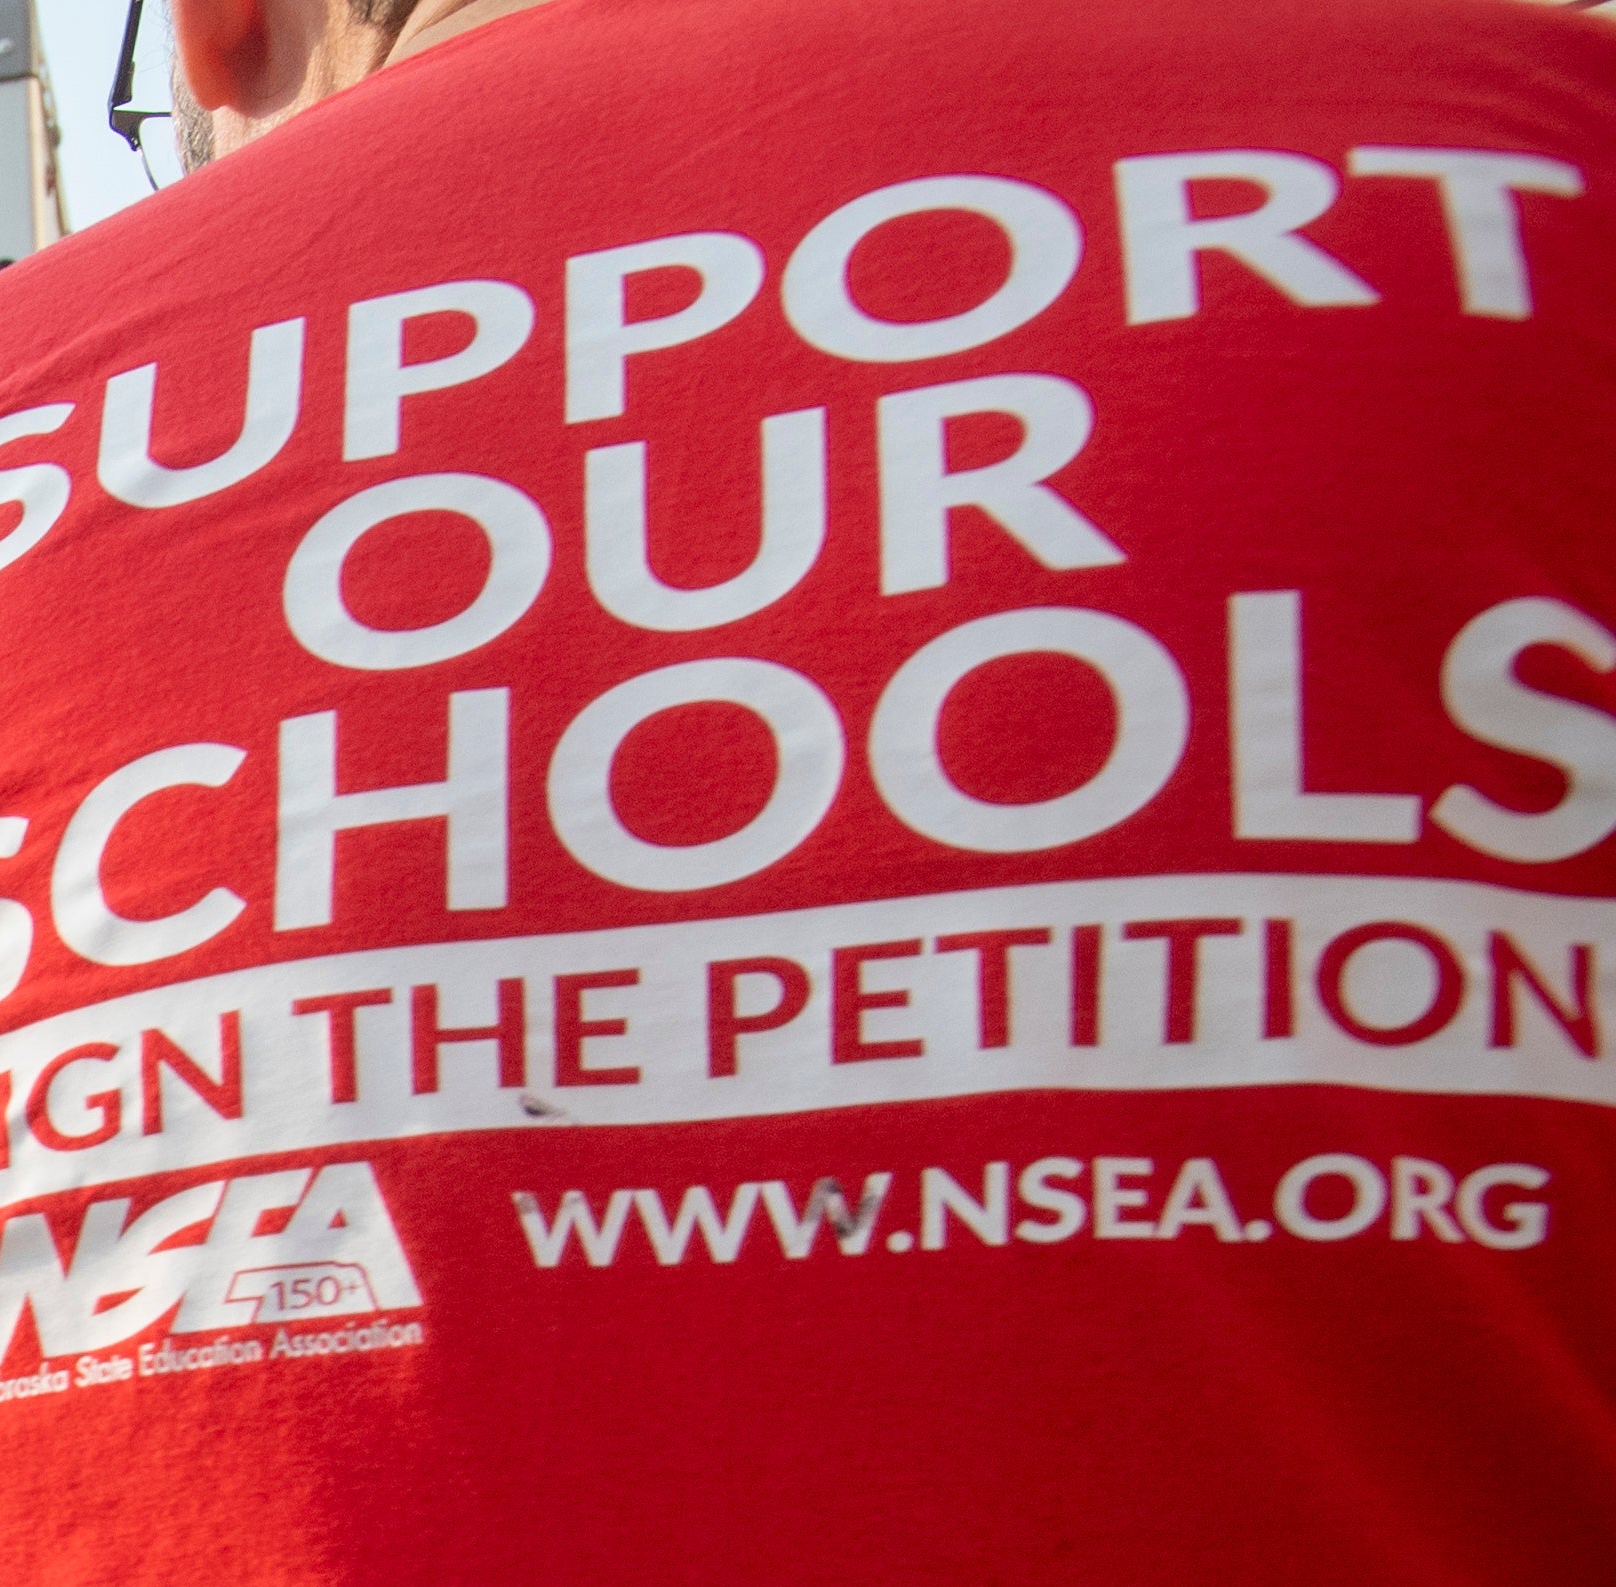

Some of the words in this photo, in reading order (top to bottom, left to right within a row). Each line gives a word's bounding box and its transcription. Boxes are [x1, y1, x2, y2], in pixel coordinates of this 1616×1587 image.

[282, 371, 1127, 672] OUR
[295, 966, 640, 1104] THE
[707, 916, 1605, 1080] PETITION
[515, 1154, 1553, 1268] WWW.NSEA.ORG
[75, 1353, 134, 1388] State
[138, 1337, 263, 1378] Education
[269, 1319, 424, 1361] Association
